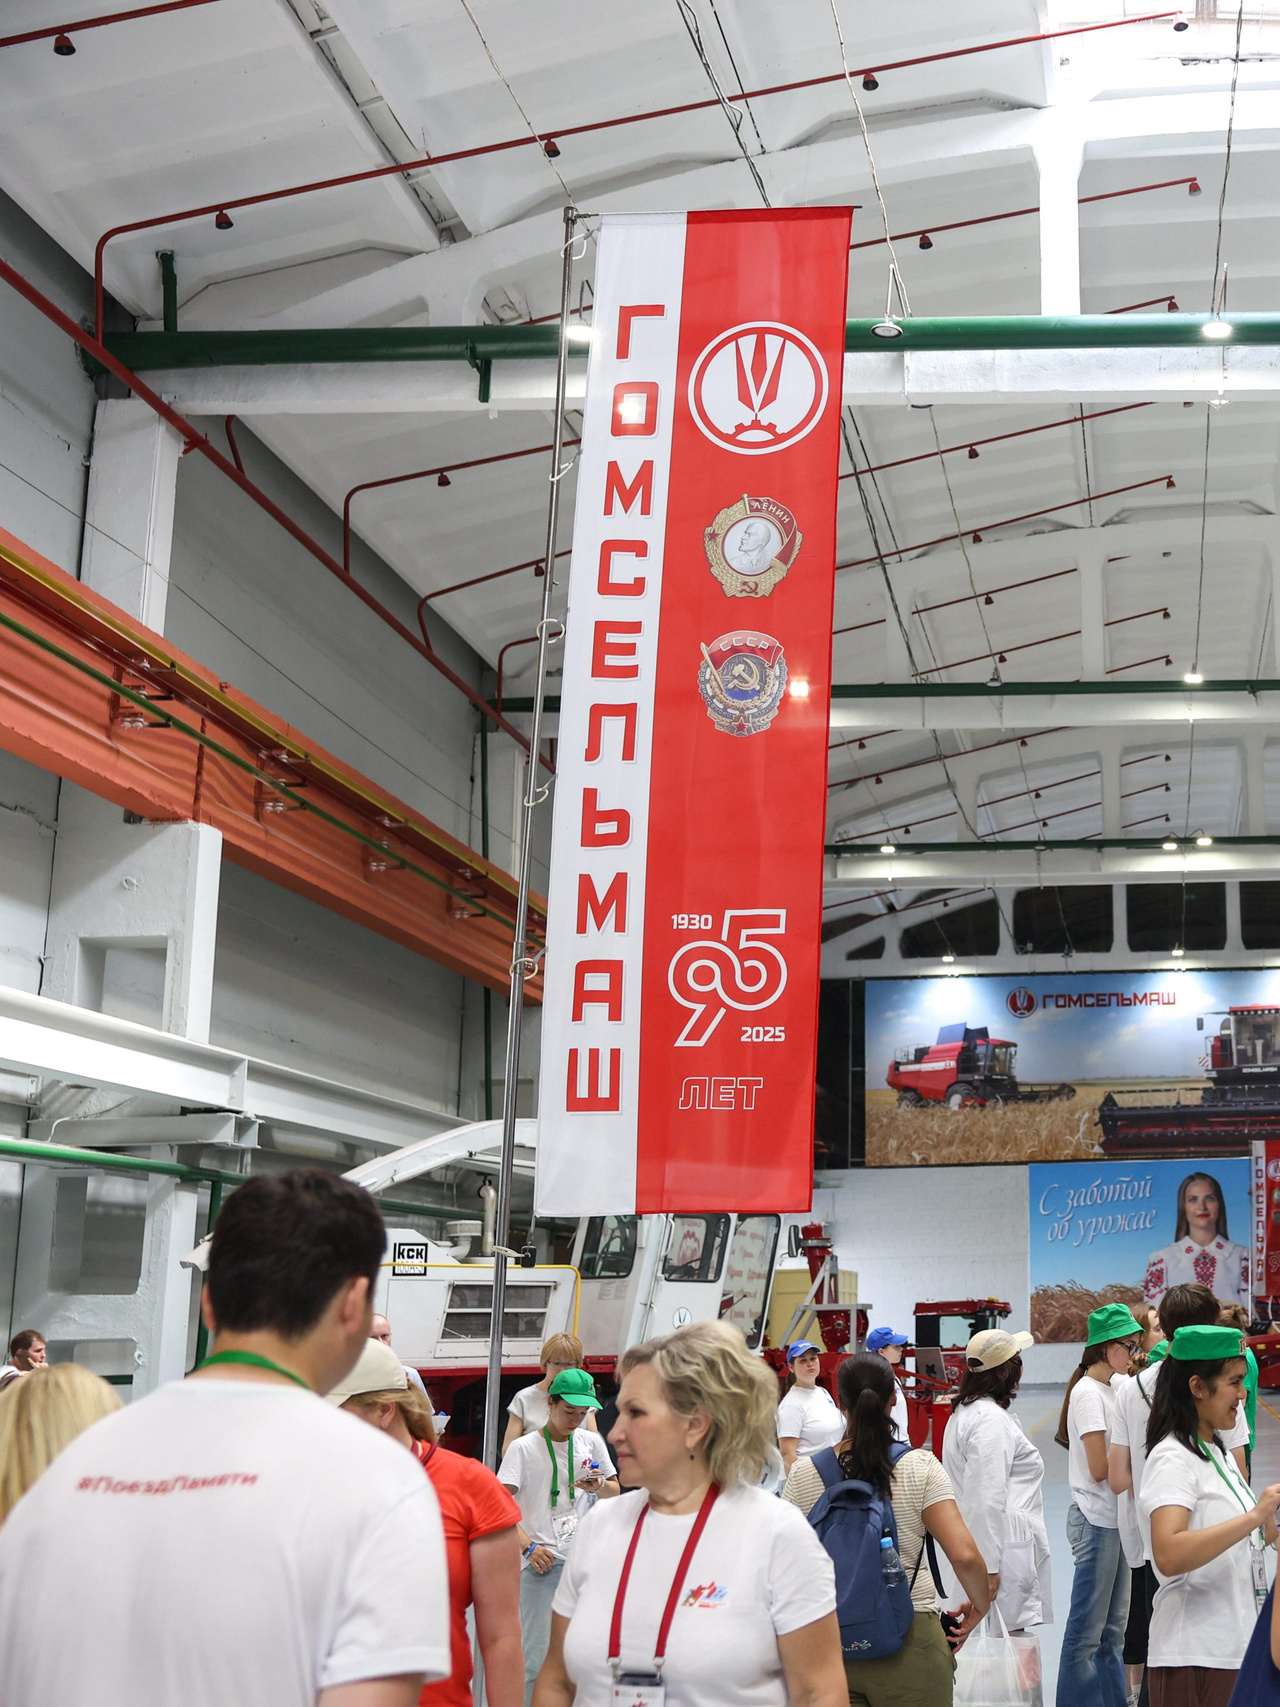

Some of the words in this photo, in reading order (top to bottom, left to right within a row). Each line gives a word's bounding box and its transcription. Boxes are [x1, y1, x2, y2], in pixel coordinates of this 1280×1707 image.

[753, 501, 791, 524] ЛЕНИН
[719, 636, 770, 652] СССР
[566, 304, 666, 1114] ГОМСЕЛЬМАШ
[671, 913, 713, 930] 1930
[667, 908, 788, 1048] 95
[1042, 992, 1176, 1009] ГОМСЕЛЬМАШ
[740, 1026, 786, 1043] 2025
[678, 1076, 764, 1111] ЛЕТ
[1040, 1183, 1059, 1215] С
[1057, 1175, 1153, 1218] заботой
[1047, 1212, 1074, 1242] об
[1073, 1209, 1158, 1247] урожае
[397, 1247, 424, 1260] КСК
[76, 1472, 259, 1495] #ПоездПамяти
